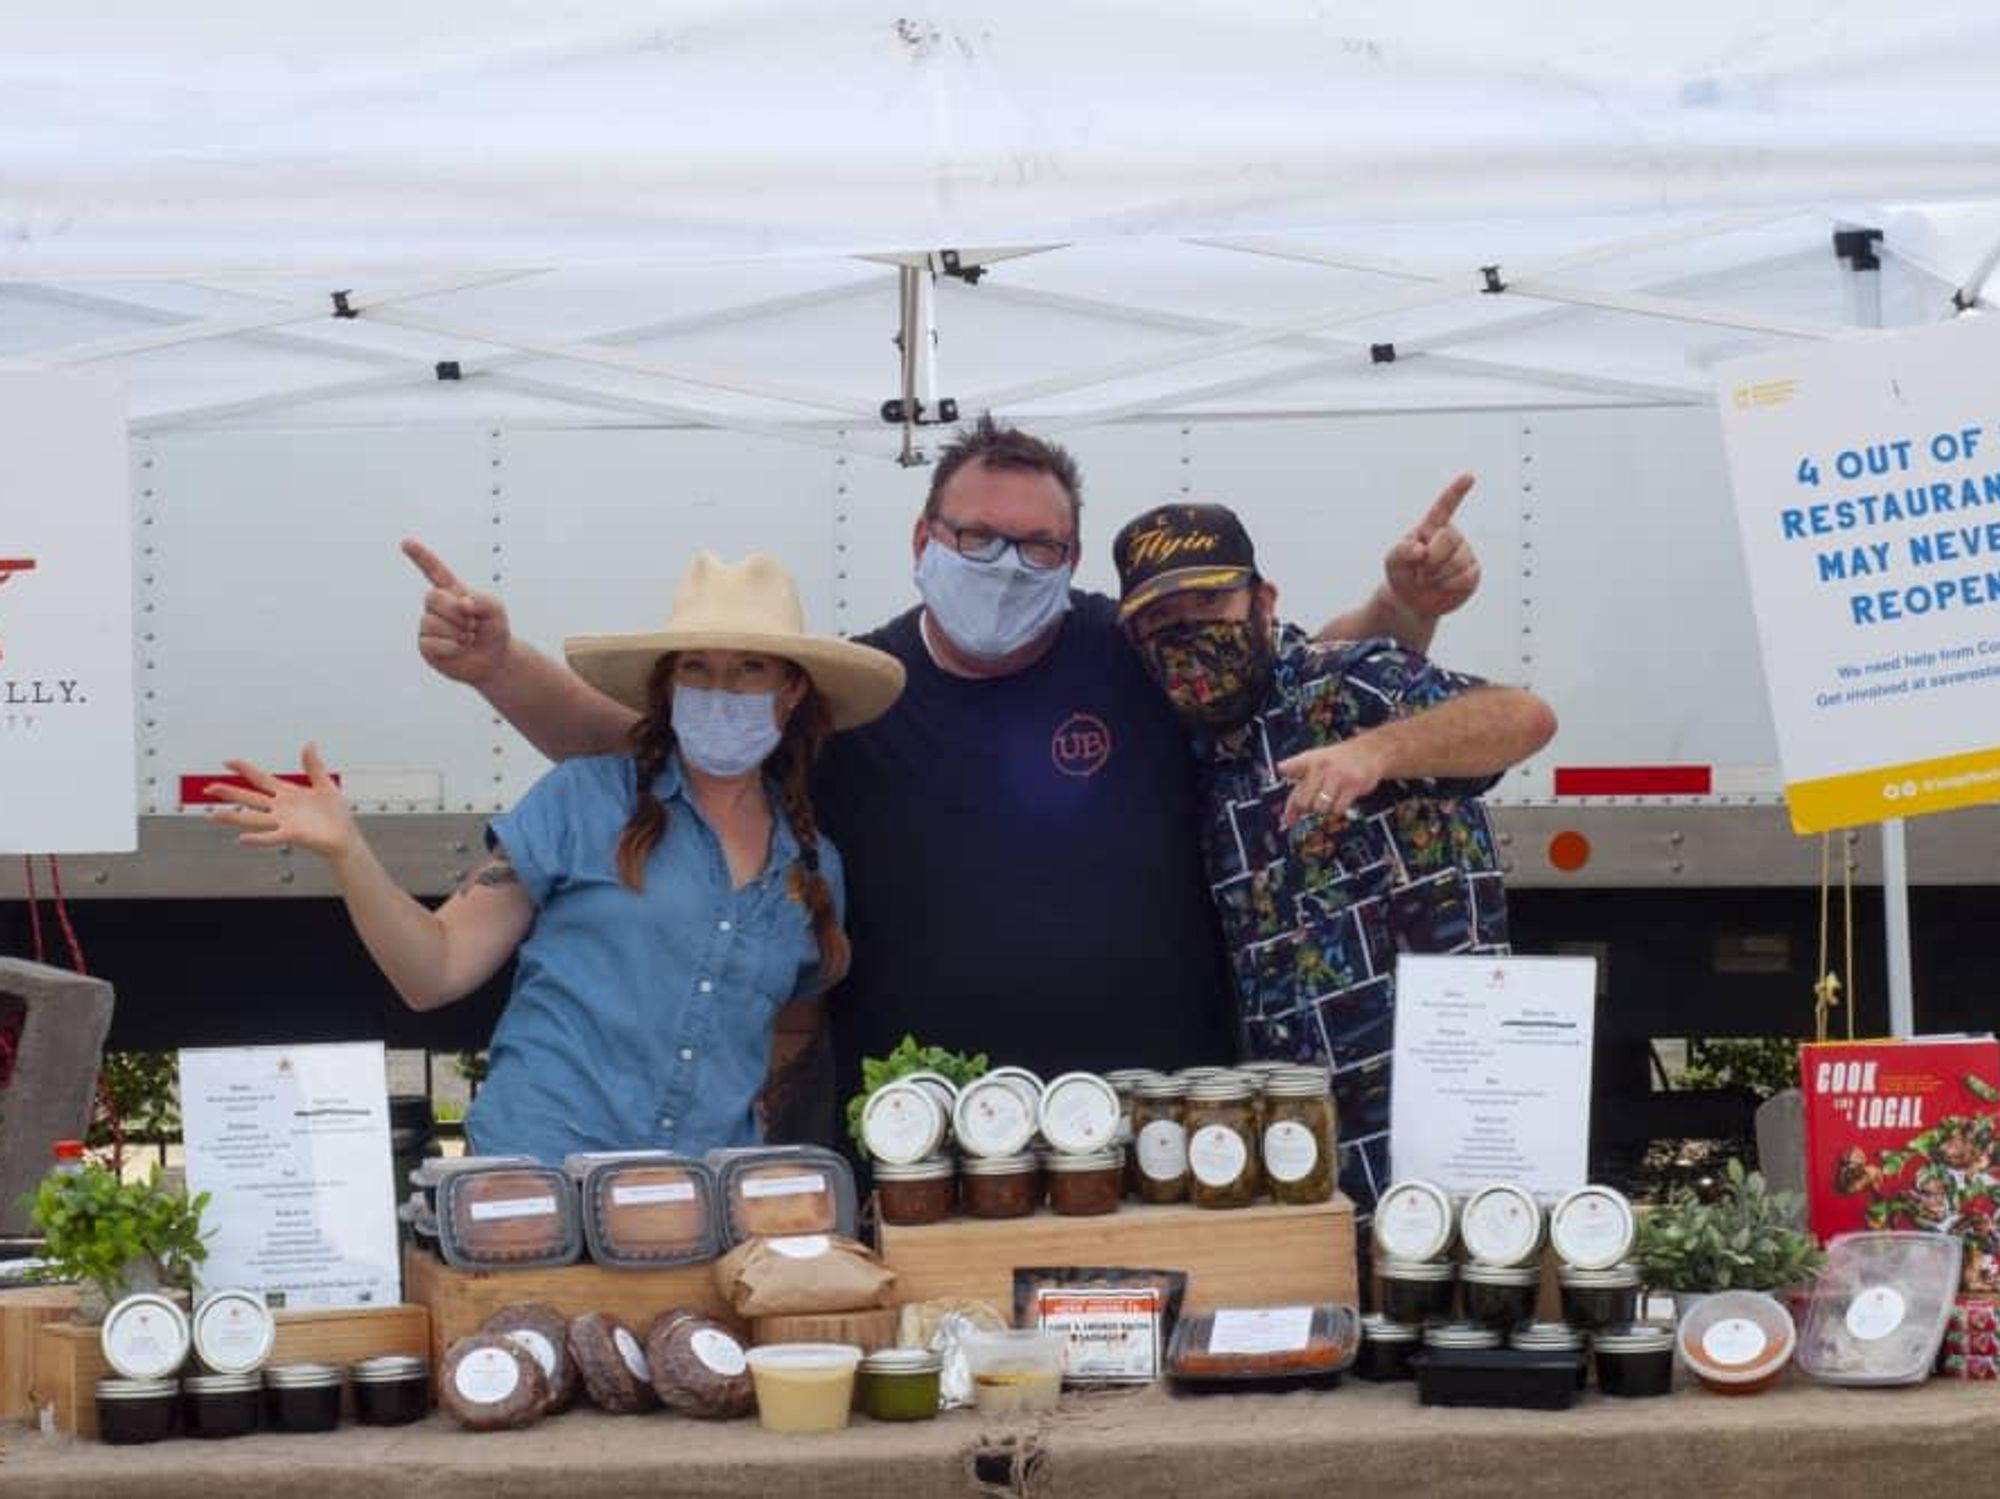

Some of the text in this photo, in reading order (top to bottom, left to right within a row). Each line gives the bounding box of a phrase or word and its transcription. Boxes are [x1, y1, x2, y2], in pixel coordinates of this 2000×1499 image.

[1797, 427, 1982, 487] 4 OUT OF
[1781, 473, 2000, 540] RESTAURAN
[1818, 521, 2000, 582] MAY NEVE
[1816, 1061, 1878, 1094] COOK
[1857, 1095, 1924, 1130] LOCAL
